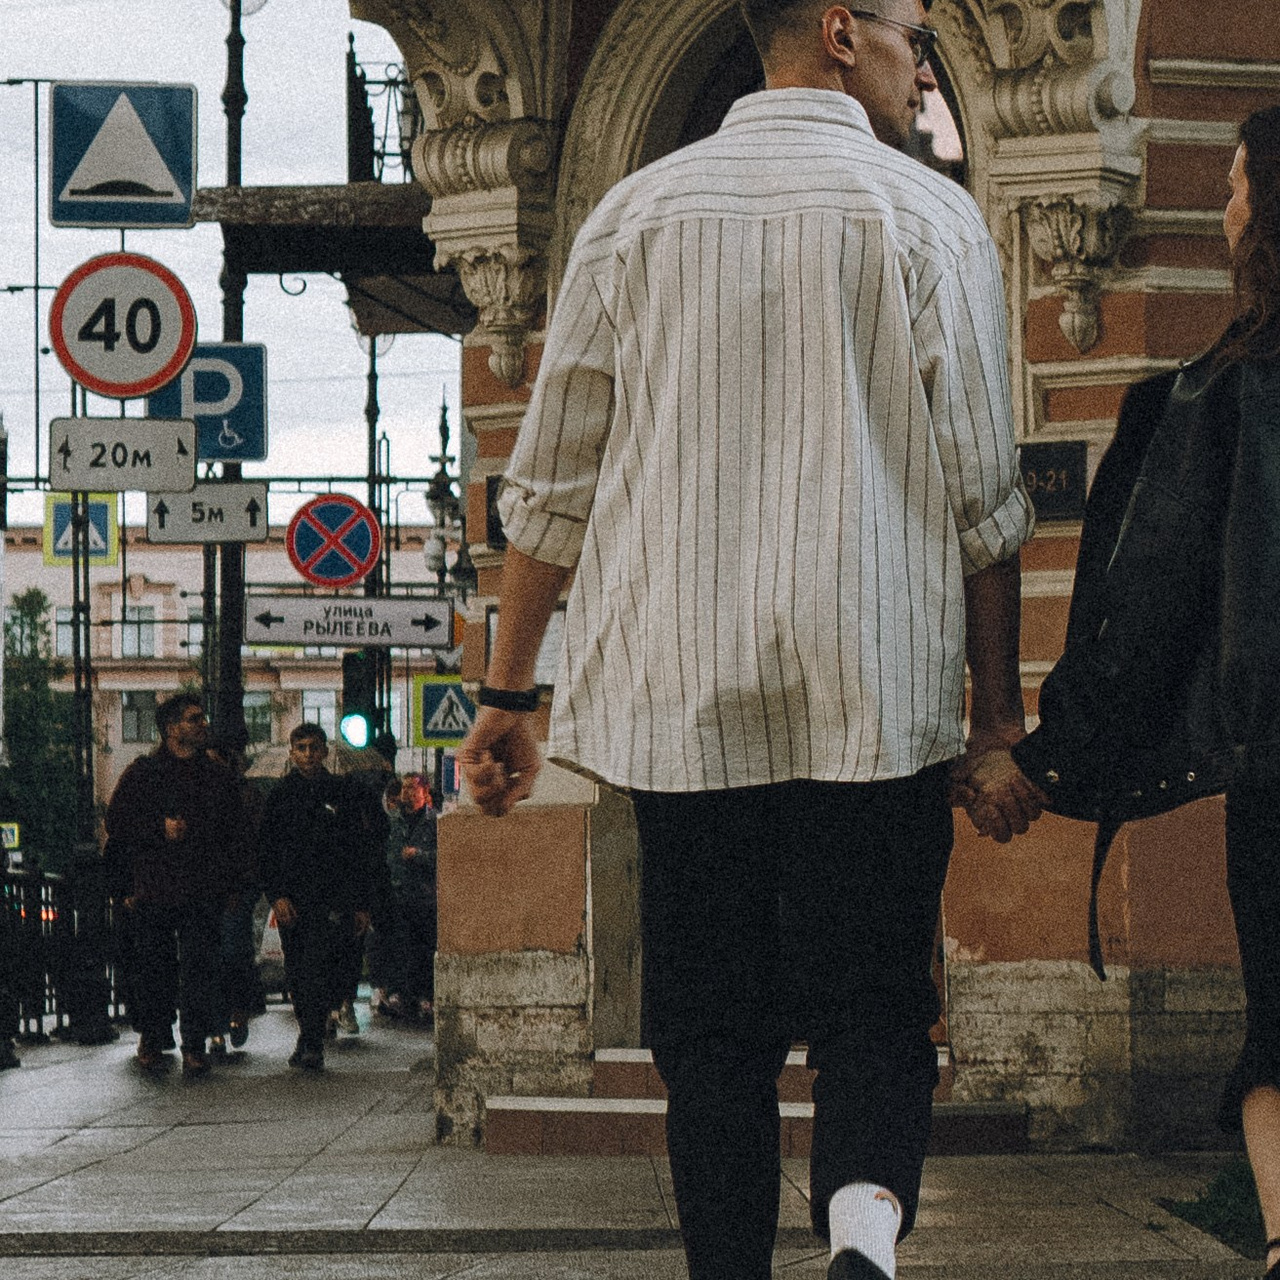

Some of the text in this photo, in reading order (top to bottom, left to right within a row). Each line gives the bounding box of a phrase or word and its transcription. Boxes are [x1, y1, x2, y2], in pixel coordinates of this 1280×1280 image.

[78, 297, 162, 354] 40
[323, 606, 373, 620] улица
[303, 621, 392, 637] РЫЛЕЕВА
